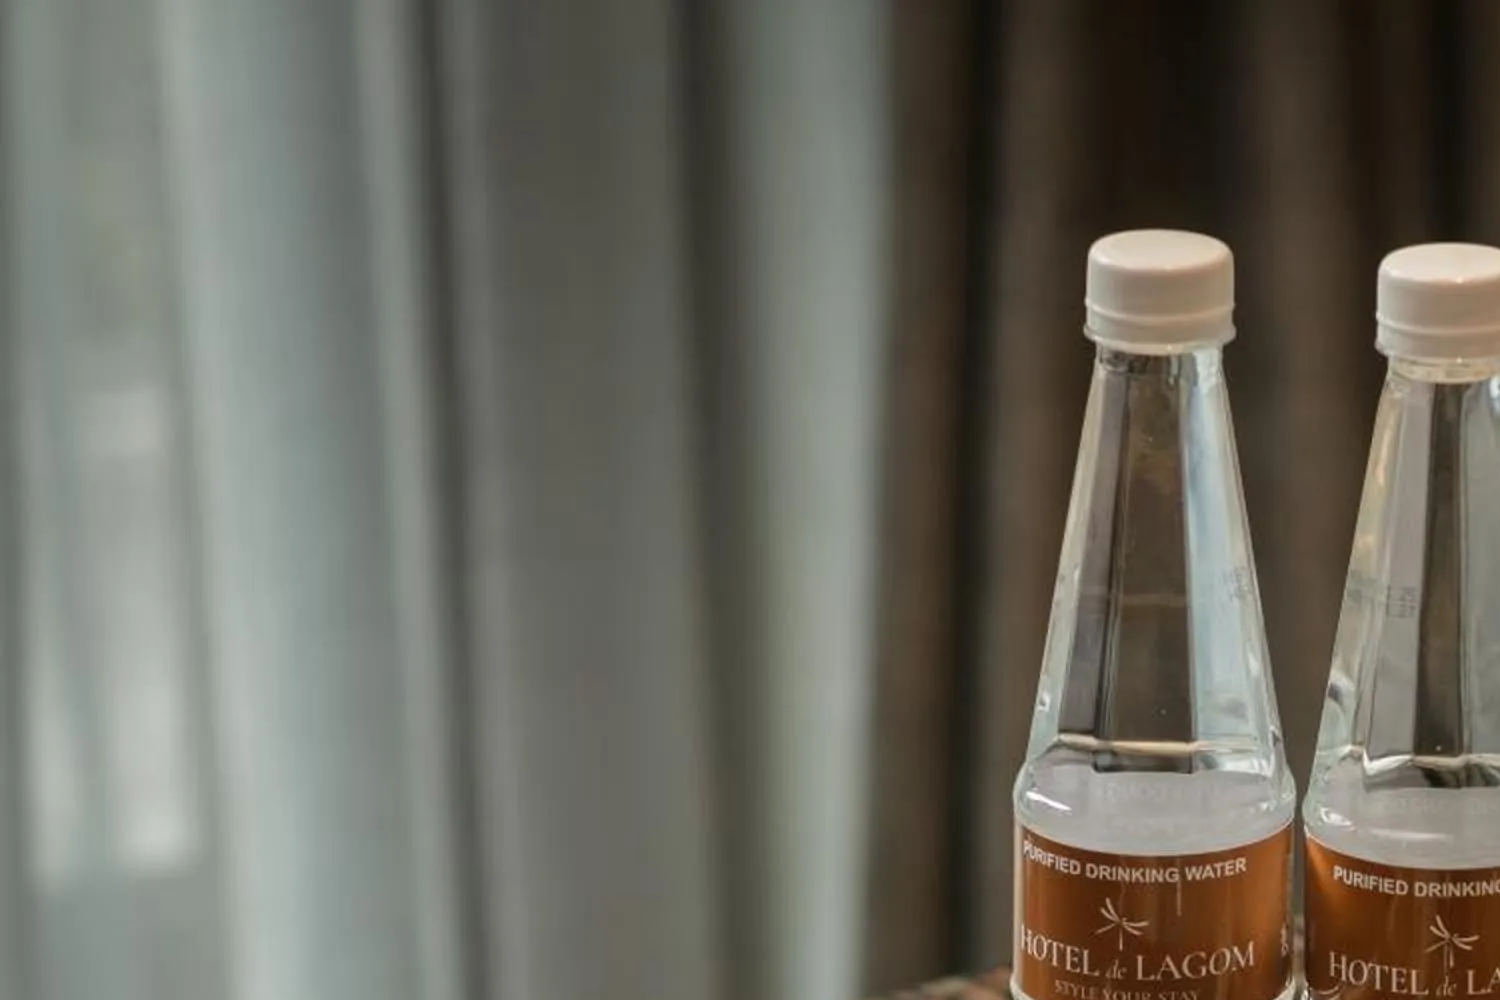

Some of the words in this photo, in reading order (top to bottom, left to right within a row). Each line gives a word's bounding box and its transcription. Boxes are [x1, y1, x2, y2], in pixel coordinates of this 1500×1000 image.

[1024, 839, 1081, 875] PURIFIED
[1086, 862, 1179, 883] DRINKING
[1186, 856, 1247, 881] WATER
[1333, 865, 1408, 896] PURIFIED
[1021, 923, 1100, 976] HOTEL
[1105, 959, 1128, 981] de
[1136, 940, 1255, 981] LAGOM
[1329, 951, 1428, 996] HOTEL
[1435, 976, 1457, 997] de
[1054, 979, 1098, 1000] STYLE
